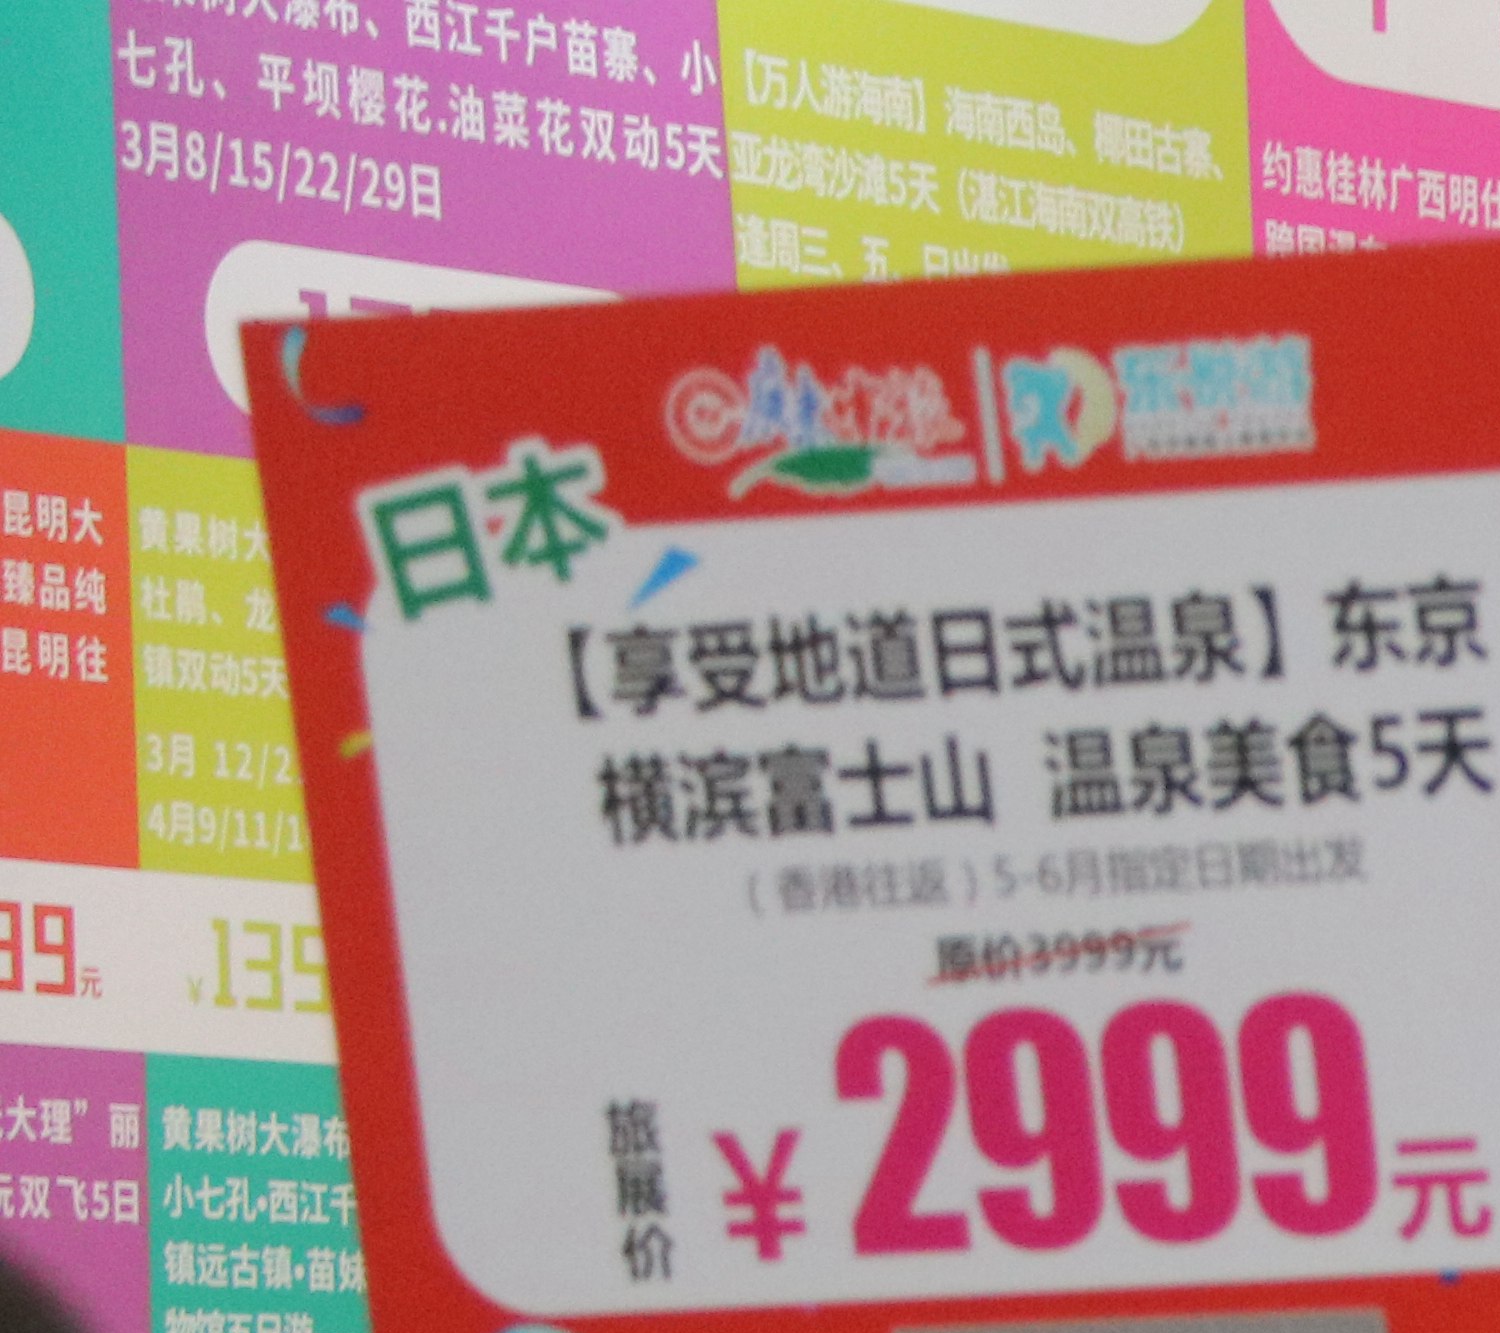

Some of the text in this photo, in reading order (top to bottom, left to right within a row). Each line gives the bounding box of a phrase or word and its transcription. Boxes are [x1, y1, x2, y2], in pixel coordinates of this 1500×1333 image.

[119, 119, 444, 222] 3月8/15/22/29日
[2, 490, 105, 547] 昆明大
[372, 450, 608, 620] 日本
[2, 627, 110, 686] 昆明往
[146, 734, 197, 778] 3月
[598, 706, 1493, 846] 横滨富士山 温泉美食5天
[161, 1103, 351, 1161] 黄果树大瀑布
[605, 1098, 674, 1283] 旅展价
